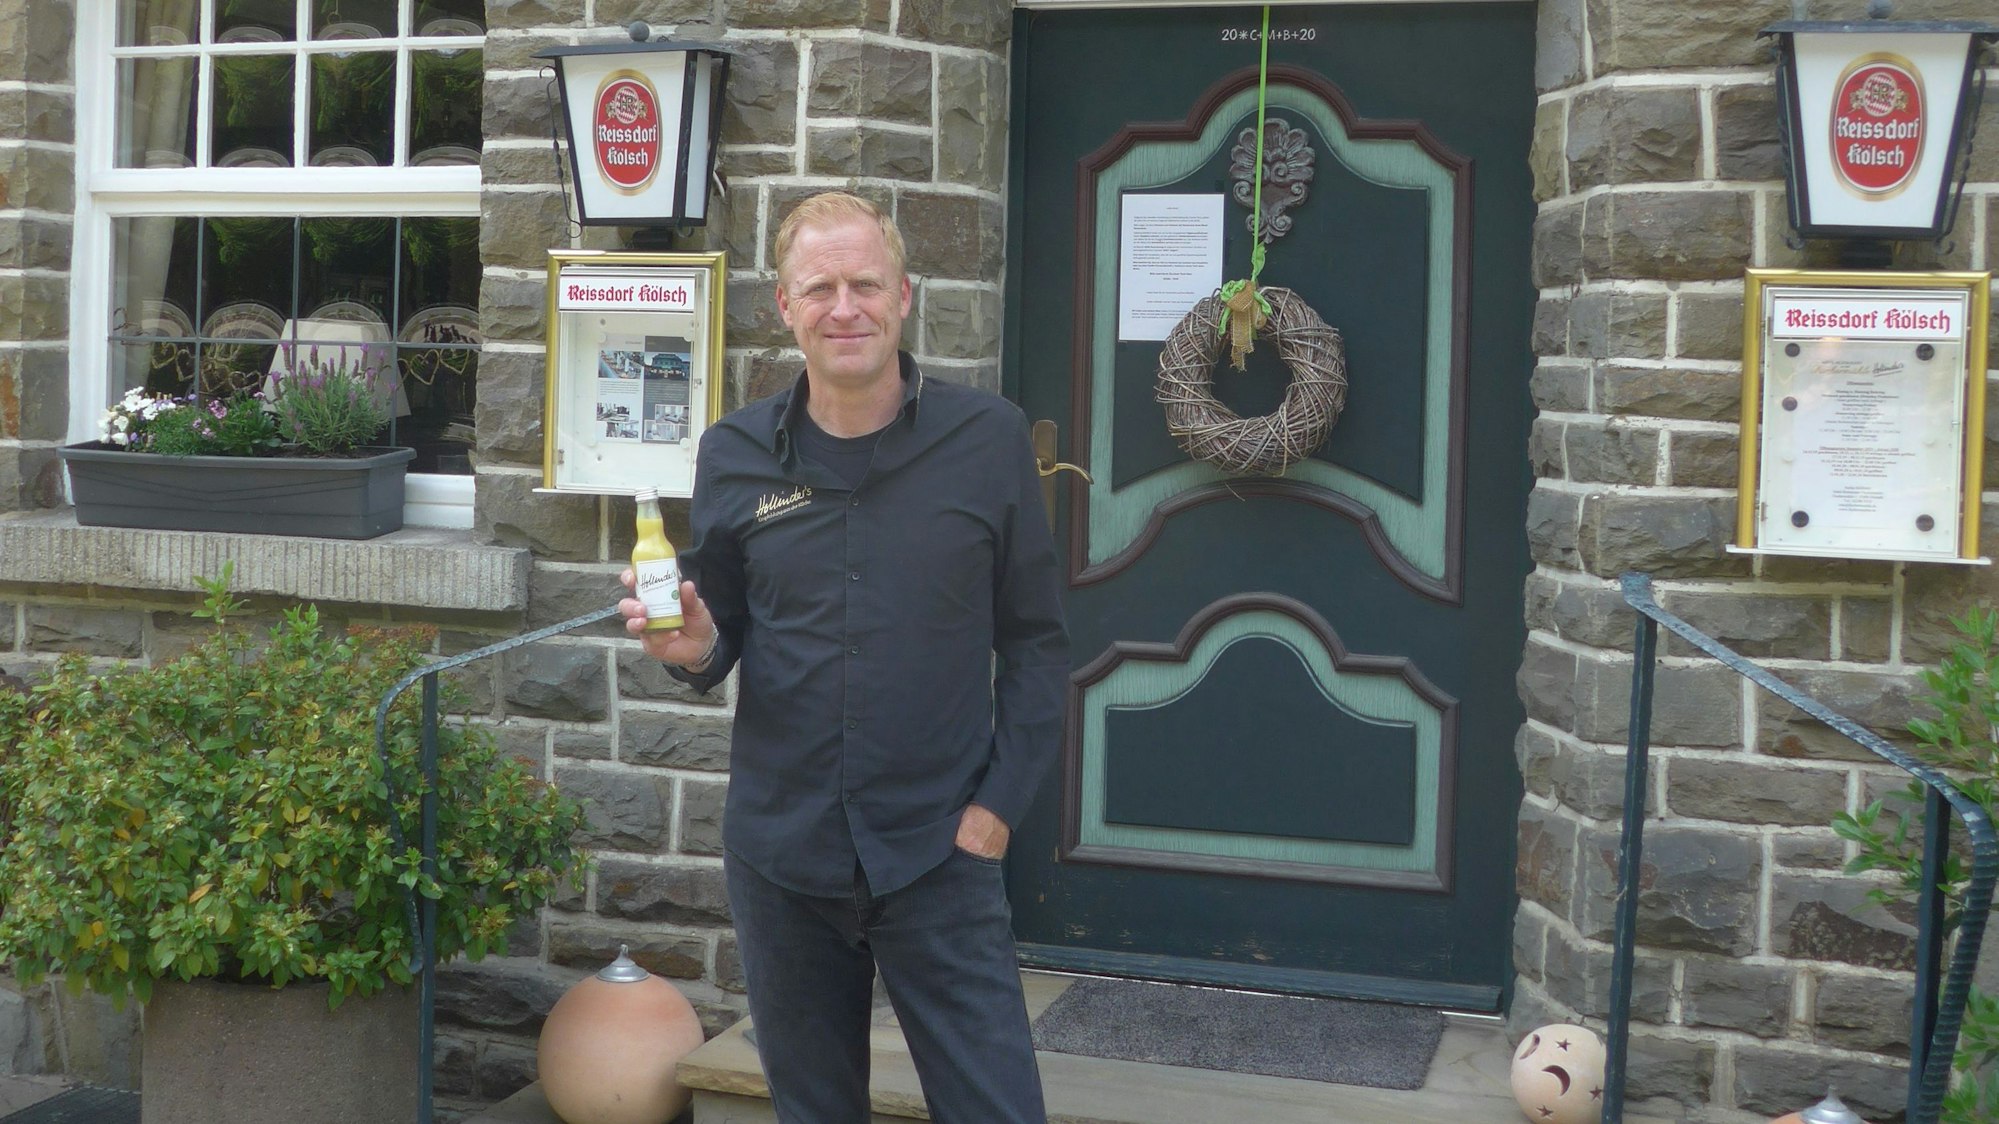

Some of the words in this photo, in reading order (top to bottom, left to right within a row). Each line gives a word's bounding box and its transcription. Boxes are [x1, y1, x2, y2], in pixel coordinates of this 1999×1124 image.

[598, 124, 657, 143] Reissdorf
[1837, 116, 1920, 139] Reissdorf
[607, 147, 649, 167] Kölsch
[1847, 143, 1905, 169] Kölsch
[567, 284, 634, 303] Reissdorf
[638, 284, 687, 307] Kölsch
[1785, 308, 1879, 329] Reissdorf
[1883, 308, 1951, 334] Kölsch
